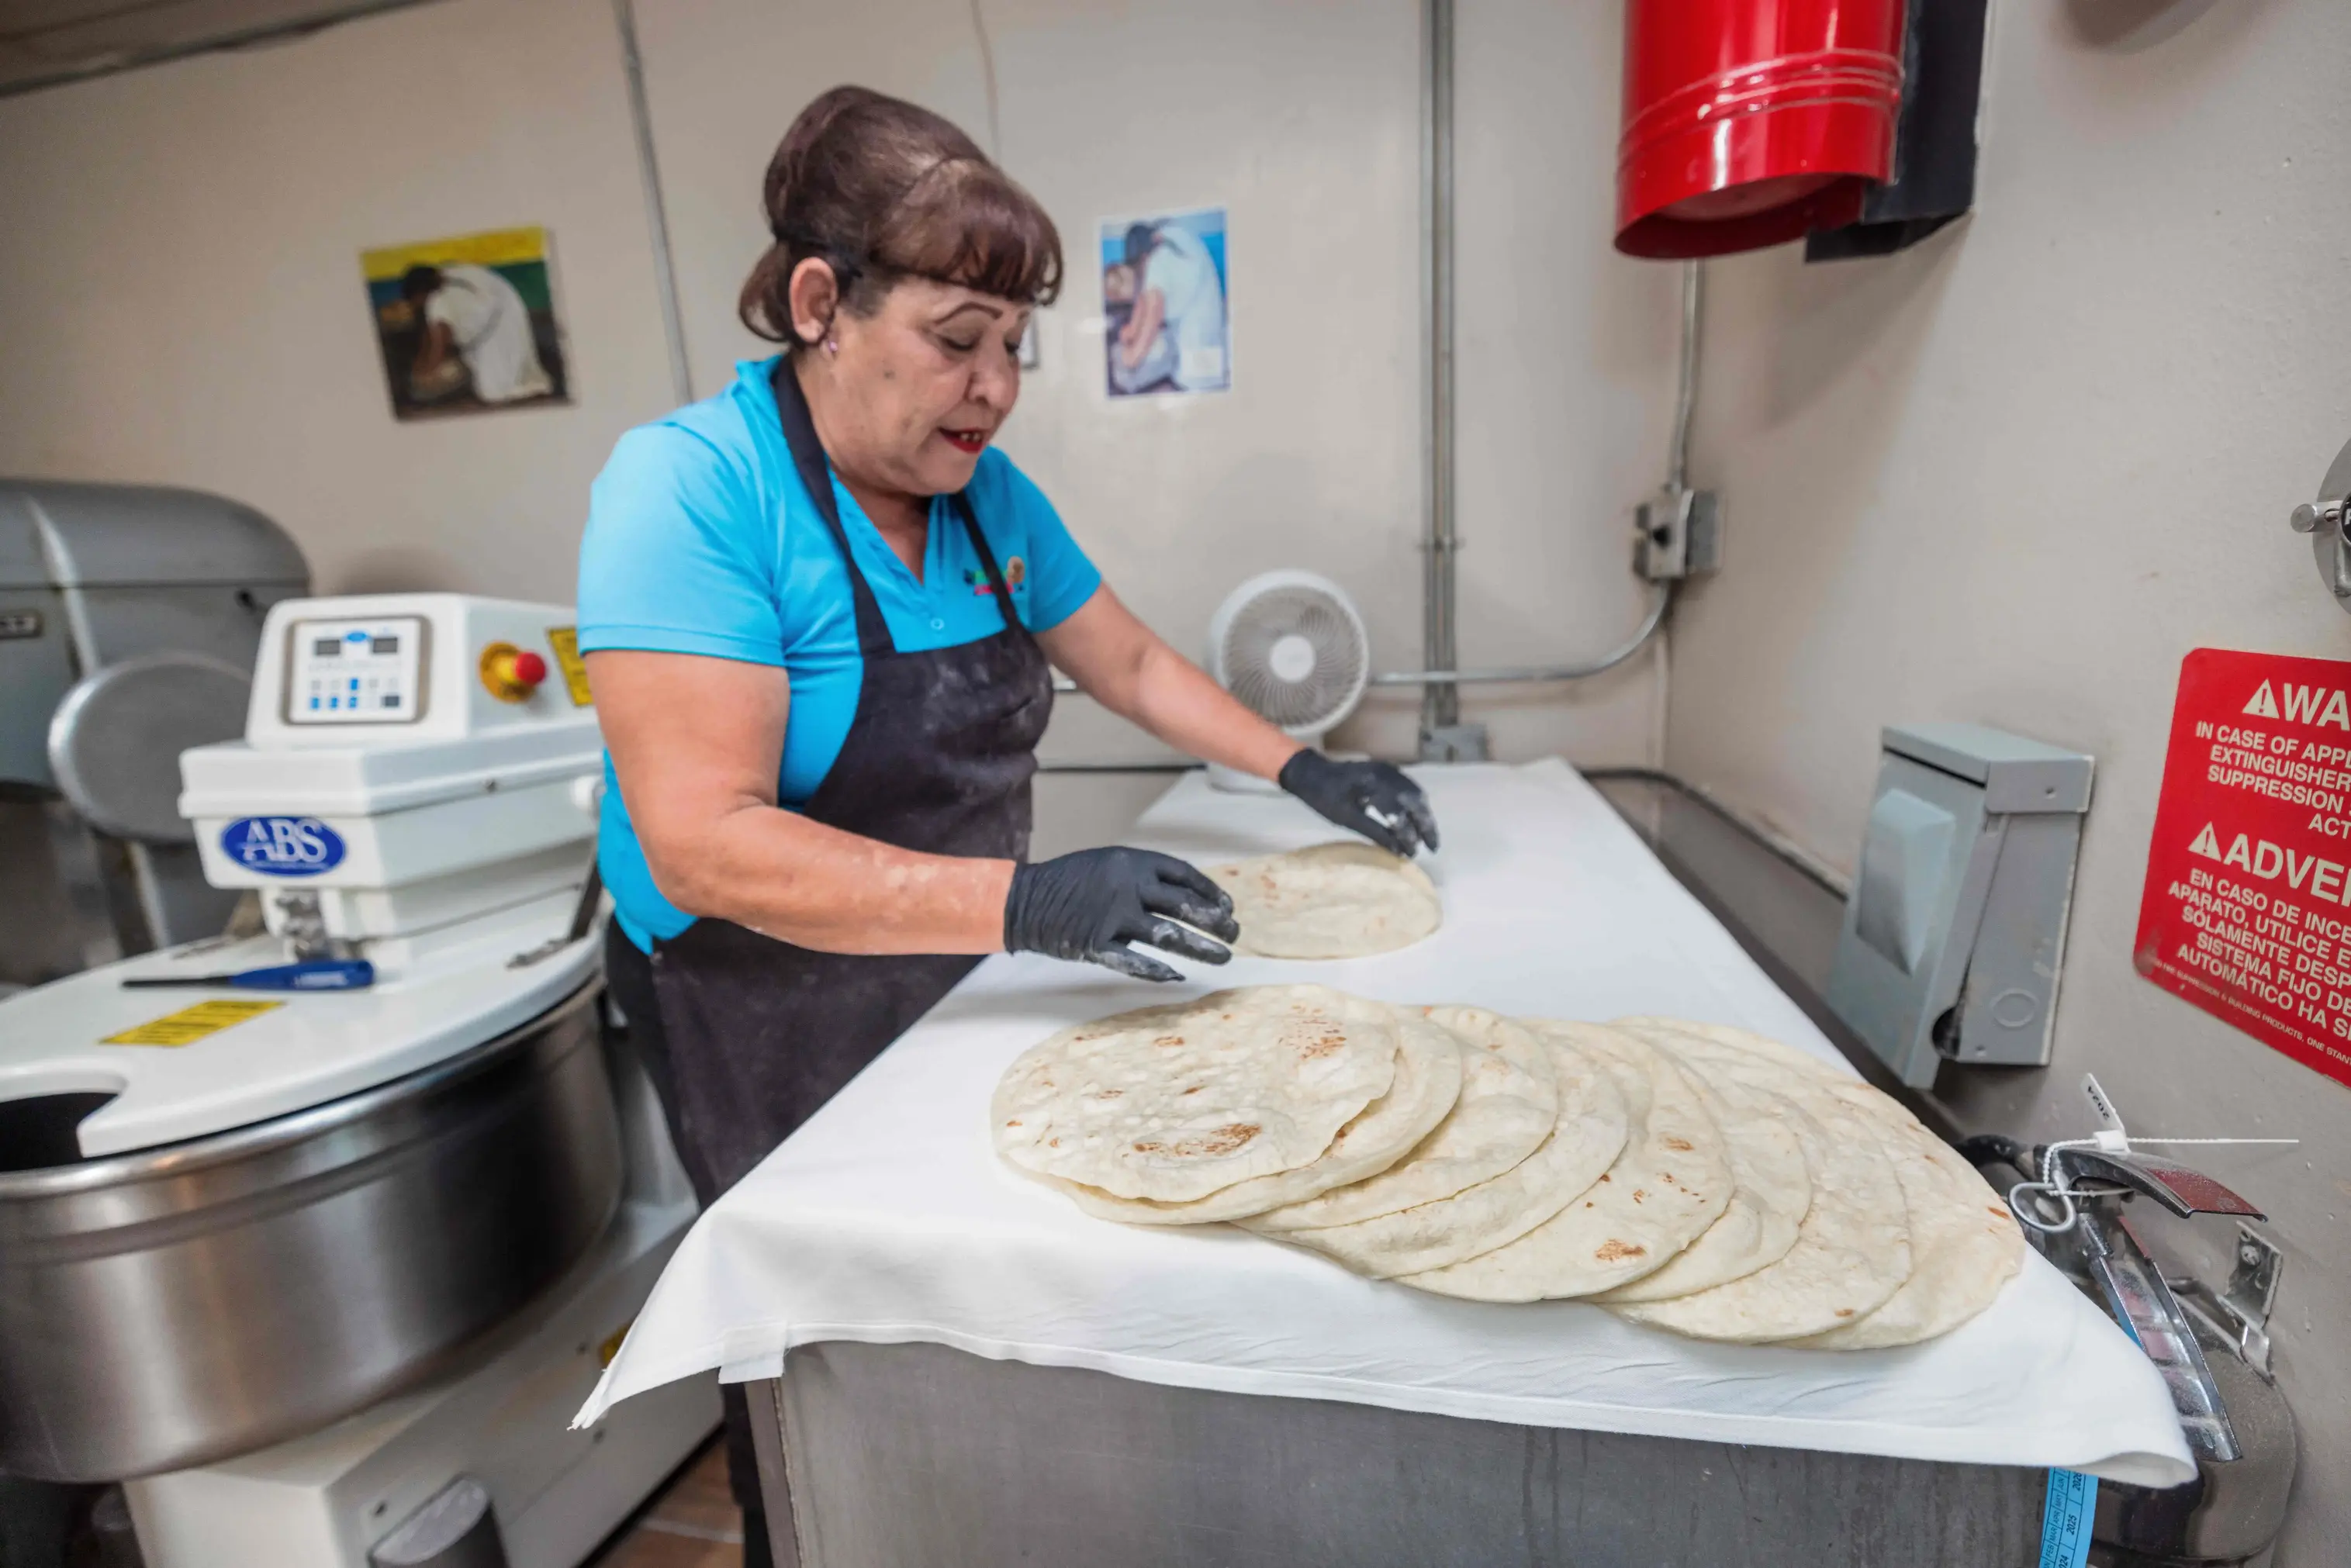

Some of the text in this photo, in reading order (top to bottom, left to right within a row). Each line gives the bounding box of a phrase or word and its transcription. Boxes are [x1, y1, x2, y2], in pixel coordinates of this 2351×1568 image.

[2284, 682, 2350, 731] WA
[2196, 720, 2214, 739] IN
[2217, 725, 2266, 750] CASE
[2270, 736, 2299, 756] OF
[2208, 765, 2344, 814] SUPPRESSION
[2210, 744, 2351, 793] EXTINGUISHER
[237, 818, 327, 863] ABS
[2308, 813, 2351, 840] ACT
[2169, 881, 2249, 929] APARATO,
[2256, 915, 2332, 959] UTILICE
[2190, 868, 2351, 946] EN CASO DE INCE
[2176, 944, 2293, 1010] AUTOMÁTICO
[2297, 1000, 2327, 1029] HA
[2197, 931, 2272, 980] SISTEMA
[2277, 969, 2322, 1001] FIJO
[2296, 954, 2351, 989] DESP
[2307, 1036, 2325, 1052] ONE
[2066, 1514, 2077, 1535] 2025
